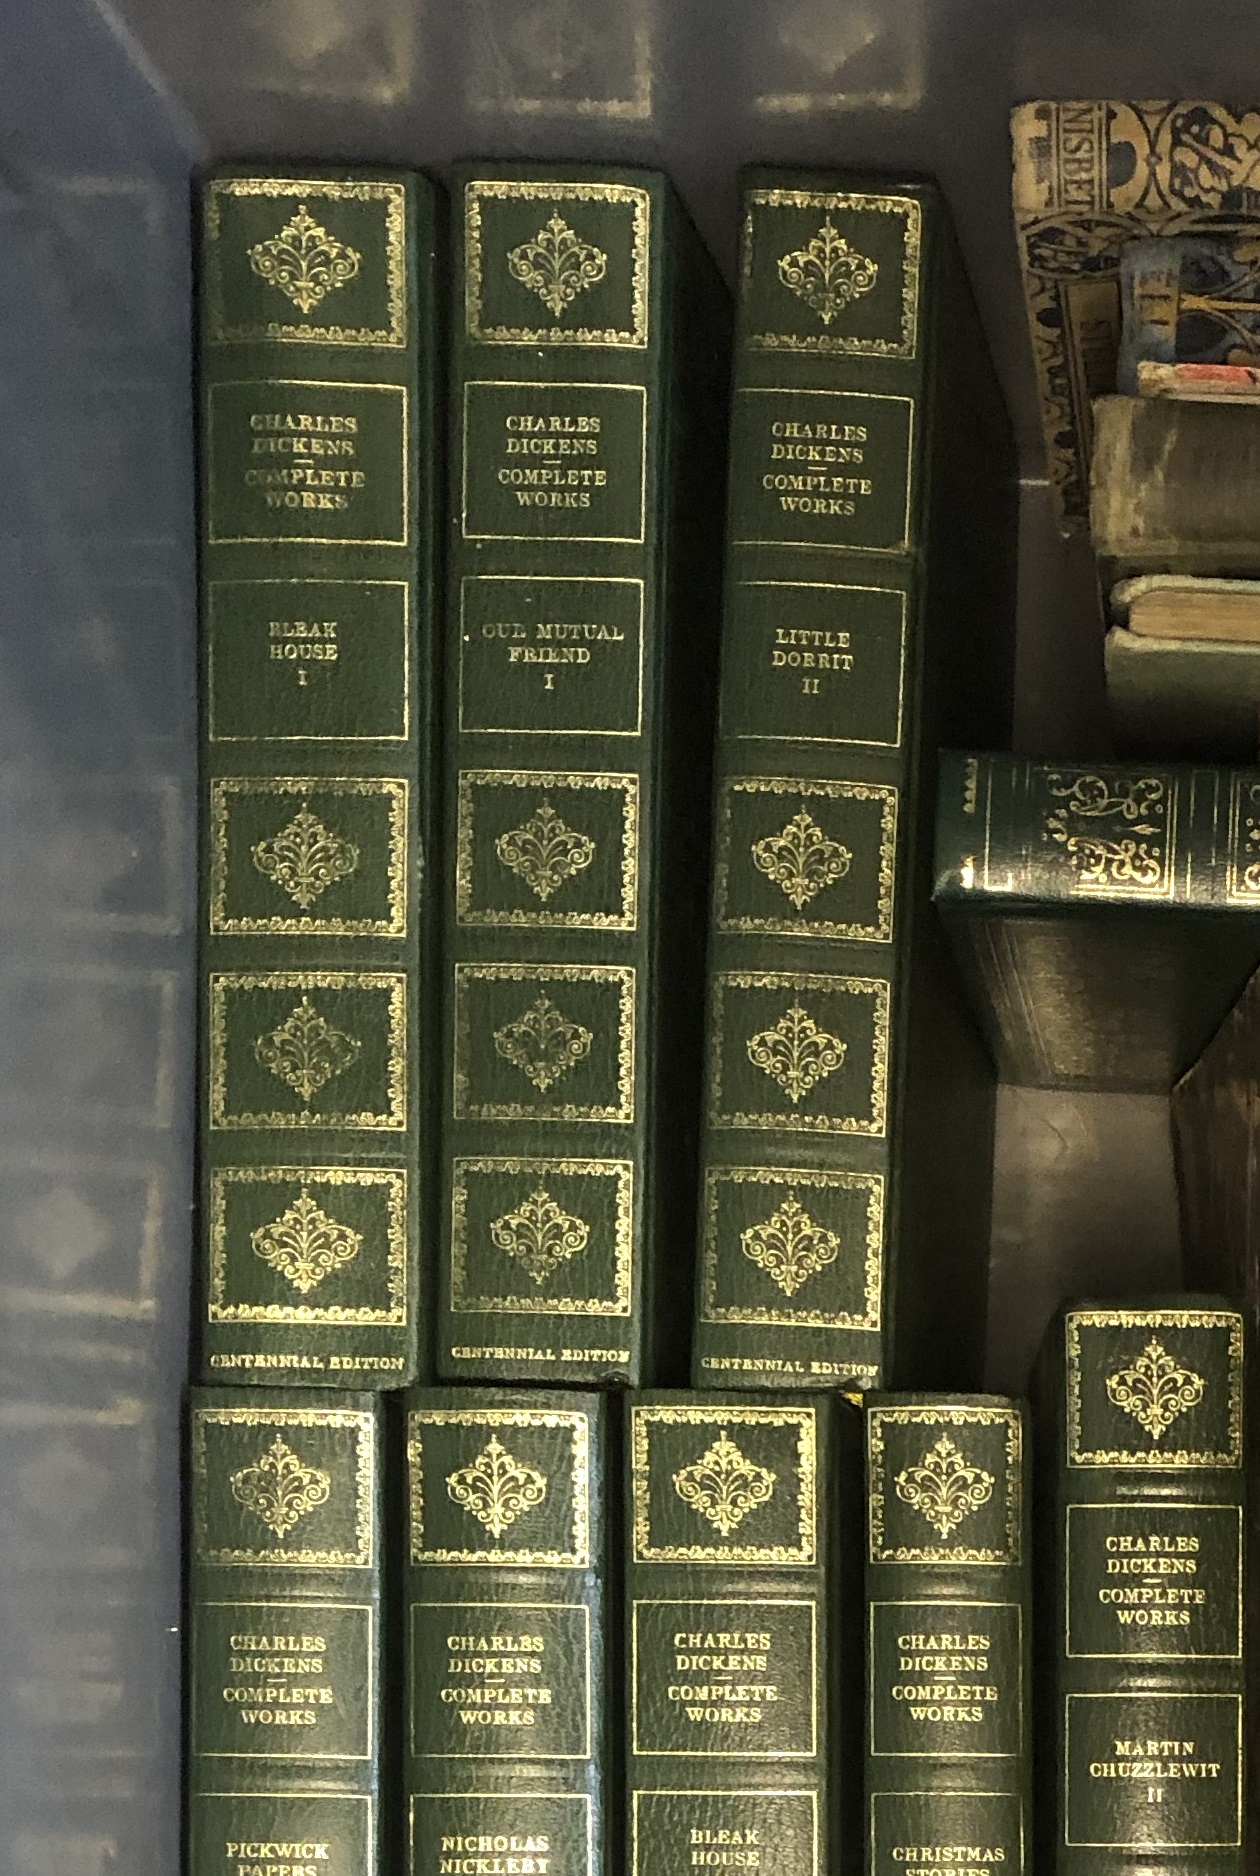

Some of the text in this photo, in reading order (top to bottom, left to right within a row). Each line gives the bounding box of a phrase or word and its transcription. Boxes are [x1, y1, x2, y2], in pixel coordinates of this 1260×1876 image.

[1062, 106, 1094, 211] NISBET
[250, 415, 358, 433] CHARLES
[505, 416, 601, 434] CHARLES
[771, 422, 867, 441] CHARLES
[252, 438, 355, 456] DICKENS
[505, 438, 598, 456] DICKENS
[770, 444, 864, 464] DICKENS
[245, 469, 366, 488] COMPLETE
[498, 468, 608, 487] COMPLETE
[762, 475, 872, 495] COMPLETE
[265, 491, 349, 510] WORKS
[516, 491, 591, 508] WORKS
[779, 497, 856, 516] WORKS
[268, 621, 338, 638] BLEAK
[536, 624, 624, 641] MUTUAL
[775, 629, 851, 648] LITTLE
[269, 644, 339, 661] HOUSE
[508, 647, 591, 664] FRIEND
[772, 651, 854, 670] DORRIT
[298, 670, 308, 686] I
[544, 674, 555, 690] I
[801, 678, 820, 694] II
[211, 1354, 405, 1371] CENTENNIAL EDITION
[450, 1347, 630, 1363] CENTENNIAL EDITION
[701, 1357, 879, 1377] CENTENNIAL EDITION
[1105, 1536, 1200, 1552] CHARLES
[1106, 1558, 1197, 1574] DICKENS
[1098, 1588, 1206, 1605] COMPLETE
[1116, 1609, 1191, 1626] WORKS
[230, 1636, 327, 1653] CHARLES
[446, 1636, 545, 1652] CHARLES
[673, 1633, 771, 1651] CHARLES
[897, 1634, 991, 1651] CHARLES
[230, 1657, 323, 1674] DICKENS
[447, 1657, 542, 1674] DICKENS
[676, 1654, 768, 1671] DICKENS
[898, 1656, 988, 1672] DICKENS
[222, 1688, 333, 1705] COMPLETE
[441, 1688, 552, 1705] COMPLETE
[667, 1685, 778, 1703] COMPLETE
[892, 1684, 998, 1701] COMPLETE
[241, 1709, 316, 1726] WORKS
[459, 1709, 535, 1726] WORKS
[686, 1707, 762, 1723] WORKS
[909, 1706, 983, 1722] WORKS
[1115, 1740, 1195, 1756] MARTIN
[1089, 1762, 1221, 1778] CHUZZLEWIT
[1147, 1786, 1163, 1803] II
[441, 1835, 549, 1853] NICHOLAS
[690, 1829, 760, 1846] BLEAK
[226, 1843, 330, 1860] PICKWICK
[690, 1851, 760, 1867] HOUSE
[892, 1846, 1005, 1863] CHRISTMAS
[440, 1858, 550, 1875] NICKLEBY
